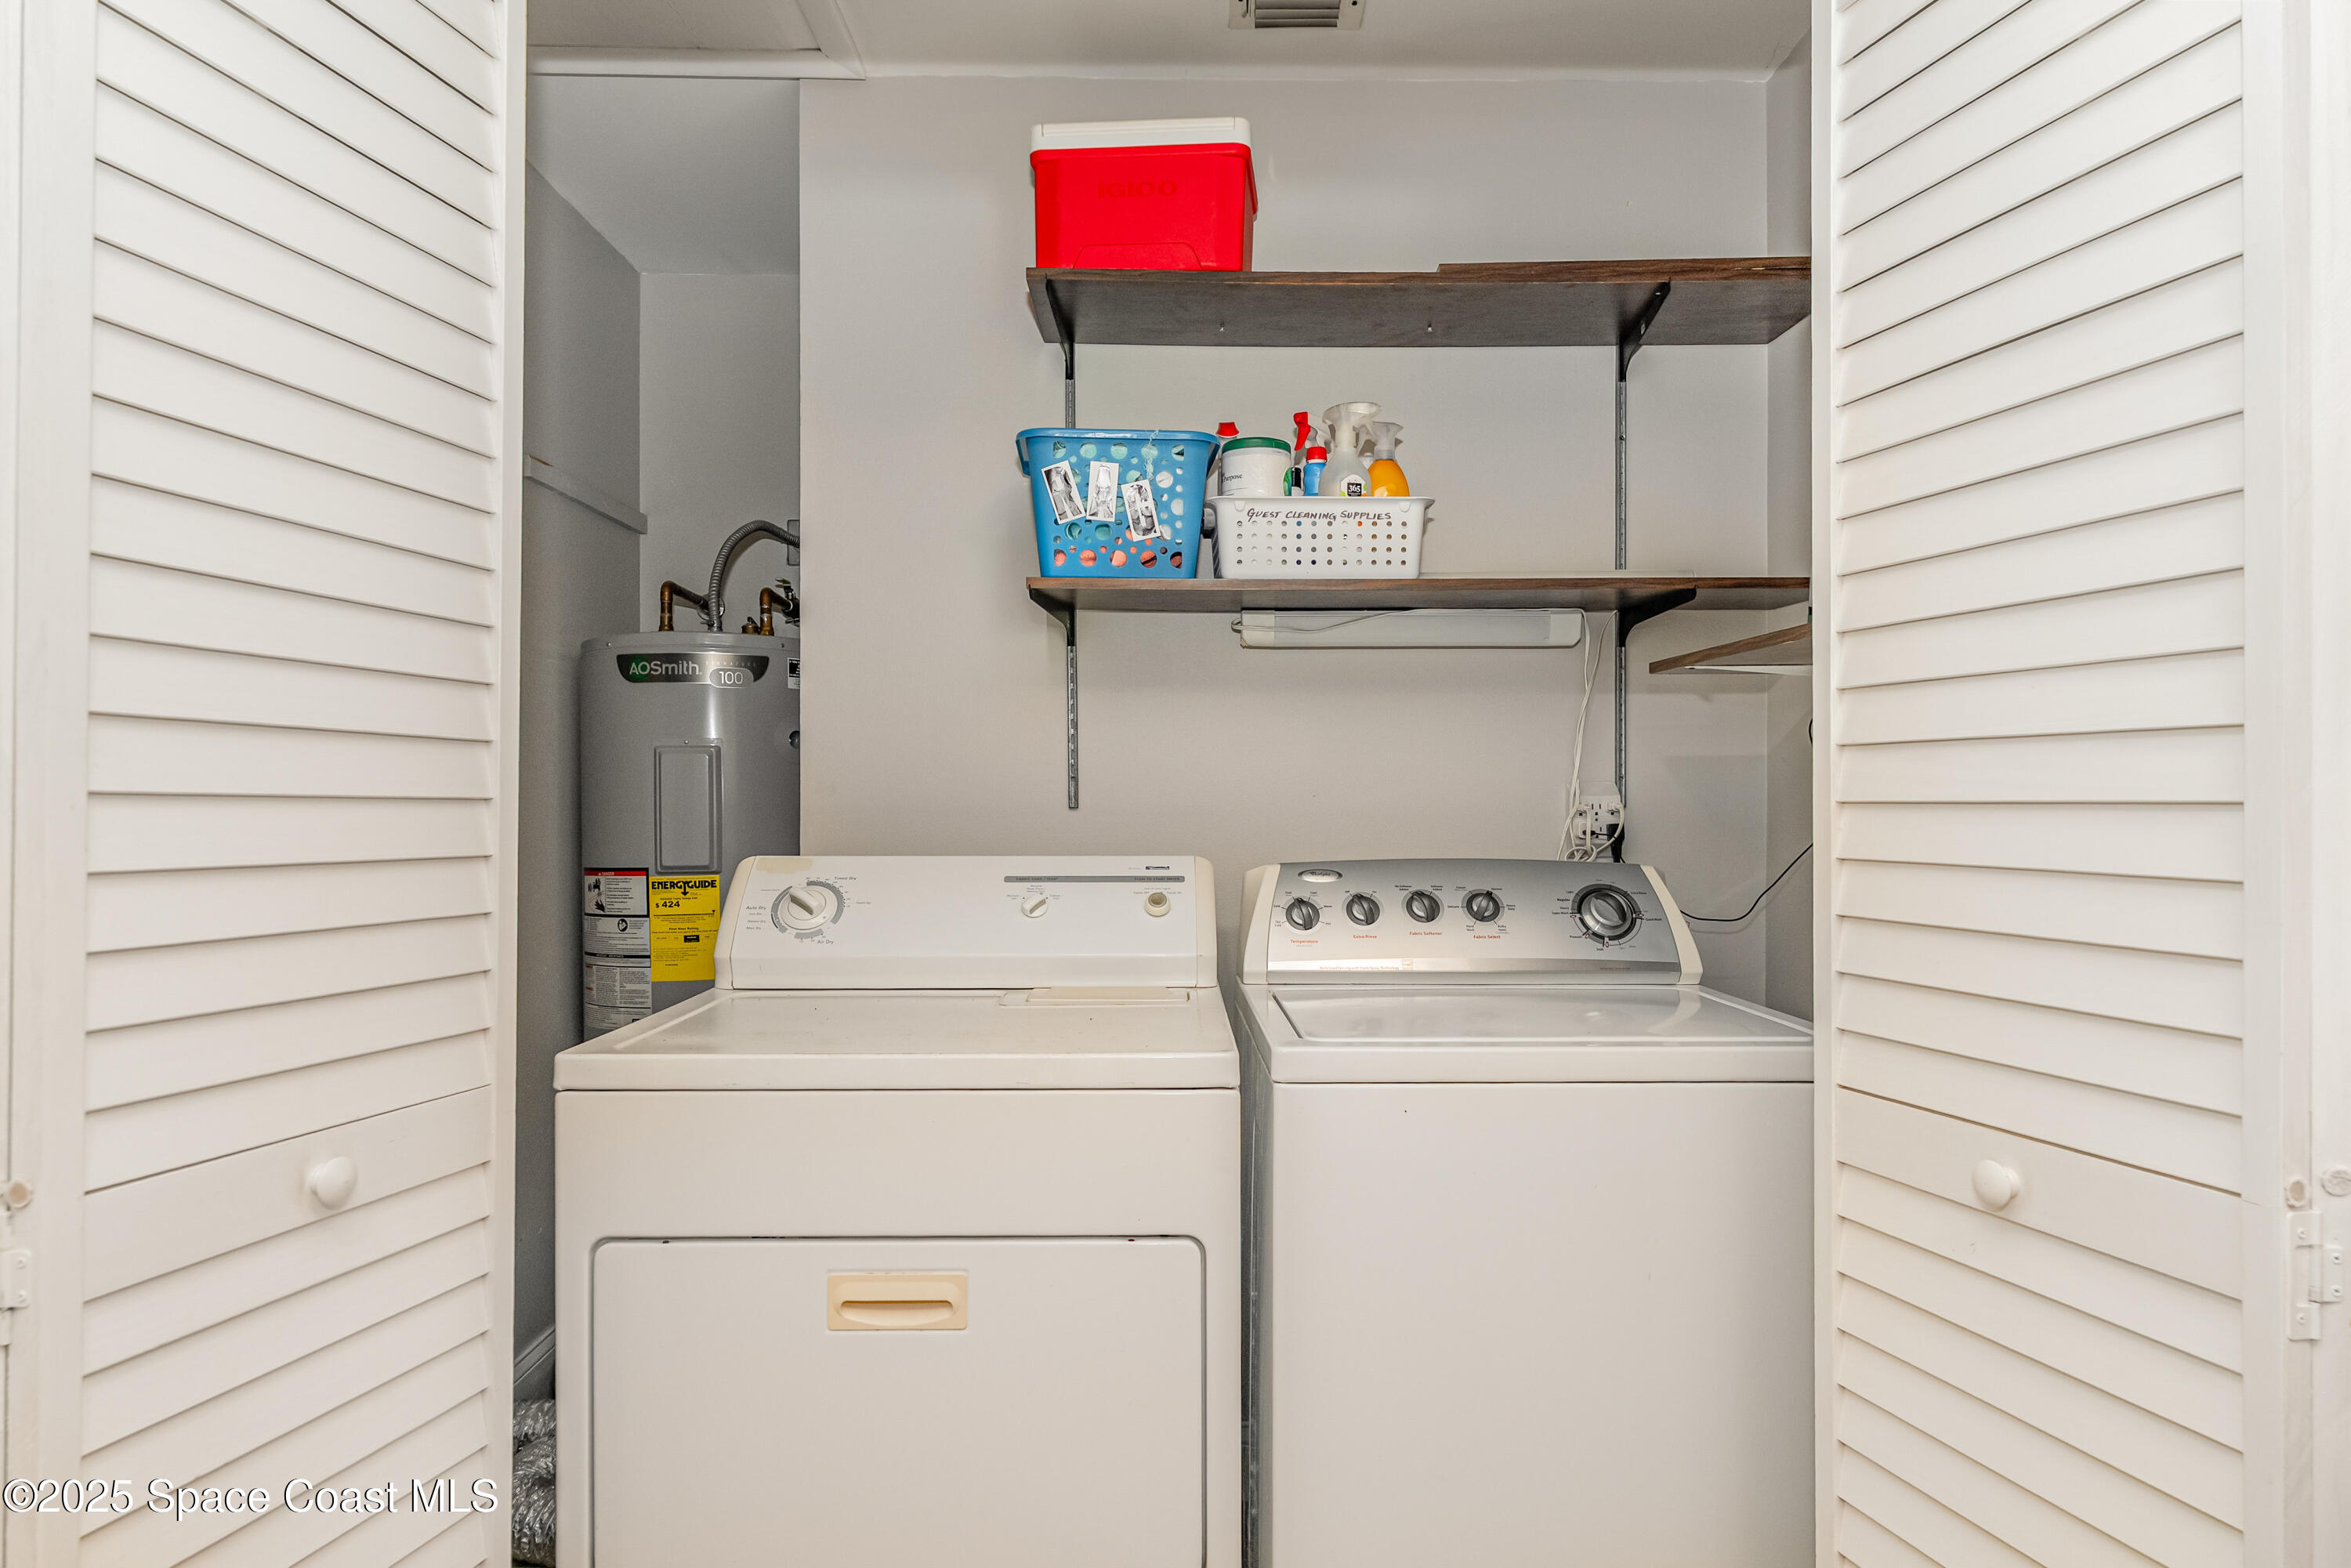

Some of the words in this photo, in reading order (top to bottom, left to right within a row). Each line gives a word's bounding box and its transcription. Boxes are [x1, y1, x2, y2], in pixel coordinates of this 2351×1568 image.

[1097, 181, 1179, 198] IGLOO
[1348, 484, 1361, 493] 365
[1247, 508, 1282, 523] GUEST
[1285, 510, 1337, 522] CLEANING
[1340, 510, 1392, 520] SUPPLIES
[719, 671, 744, 685] 100
